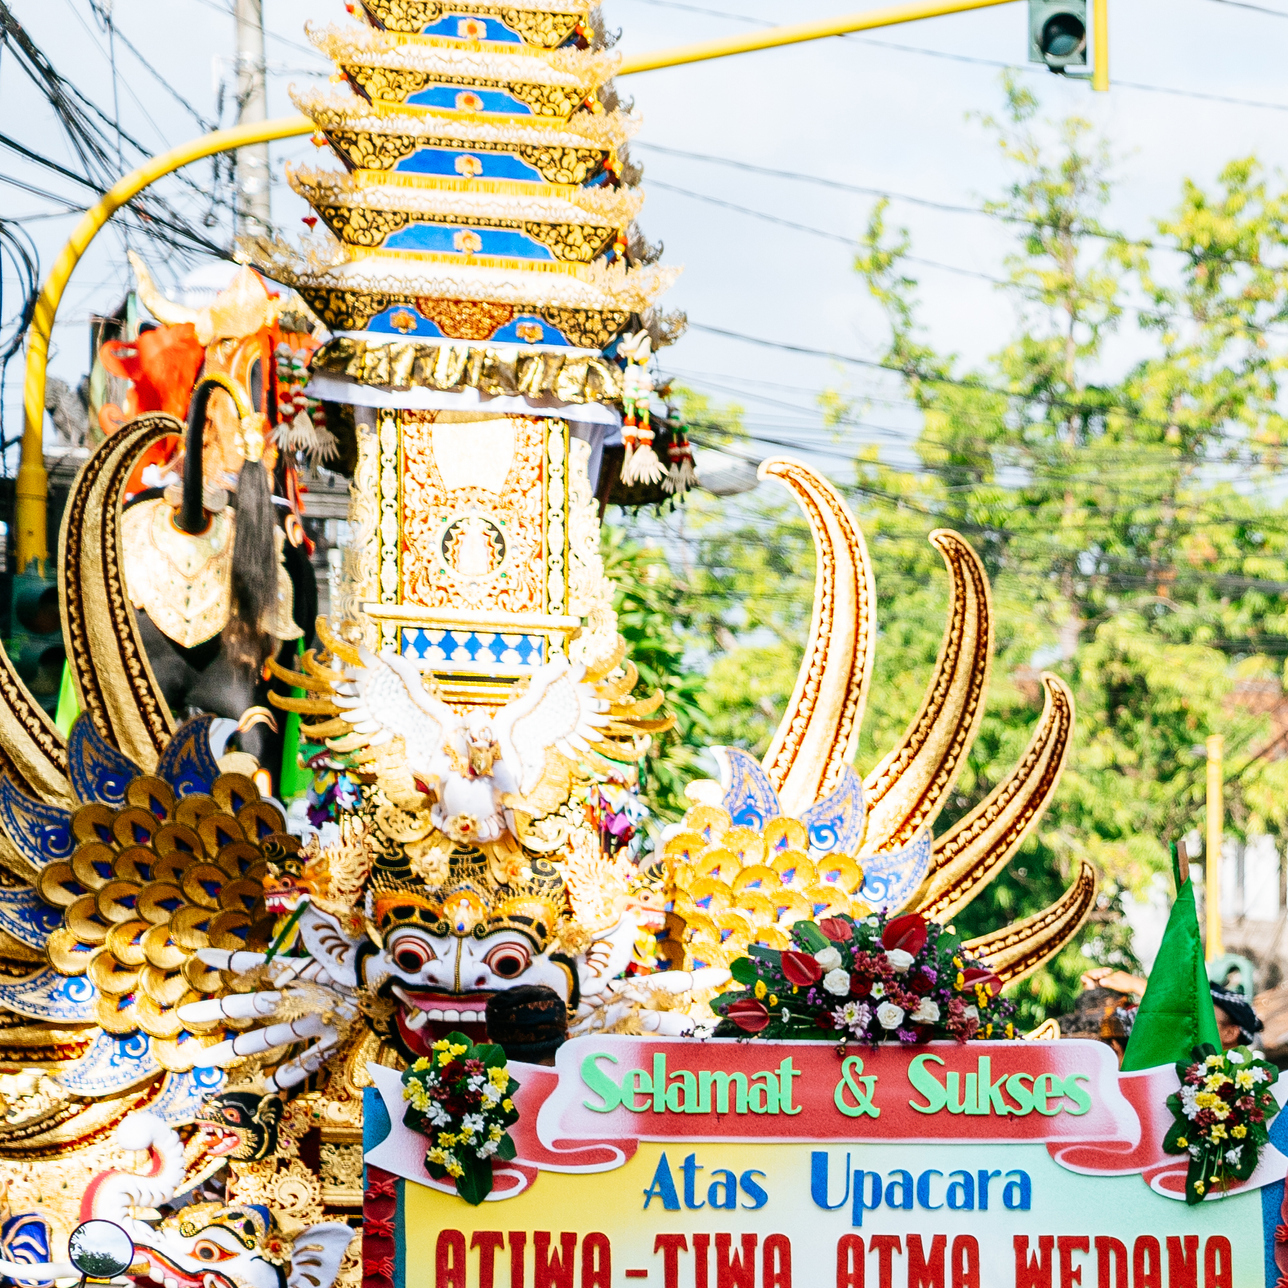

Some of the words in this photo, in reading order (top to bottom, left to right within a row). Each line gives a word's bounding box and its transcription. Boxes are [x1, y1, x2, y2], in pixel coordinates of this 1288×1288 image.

[582, 1053, 801, 1116] Selamat
[834, 1055, 880, 1118] &
[908, 1053, 1091, 1117] Sukses
[644, 1152, 768, 1211] Atas
[810, 1151, 1032, 1227] Upacara
